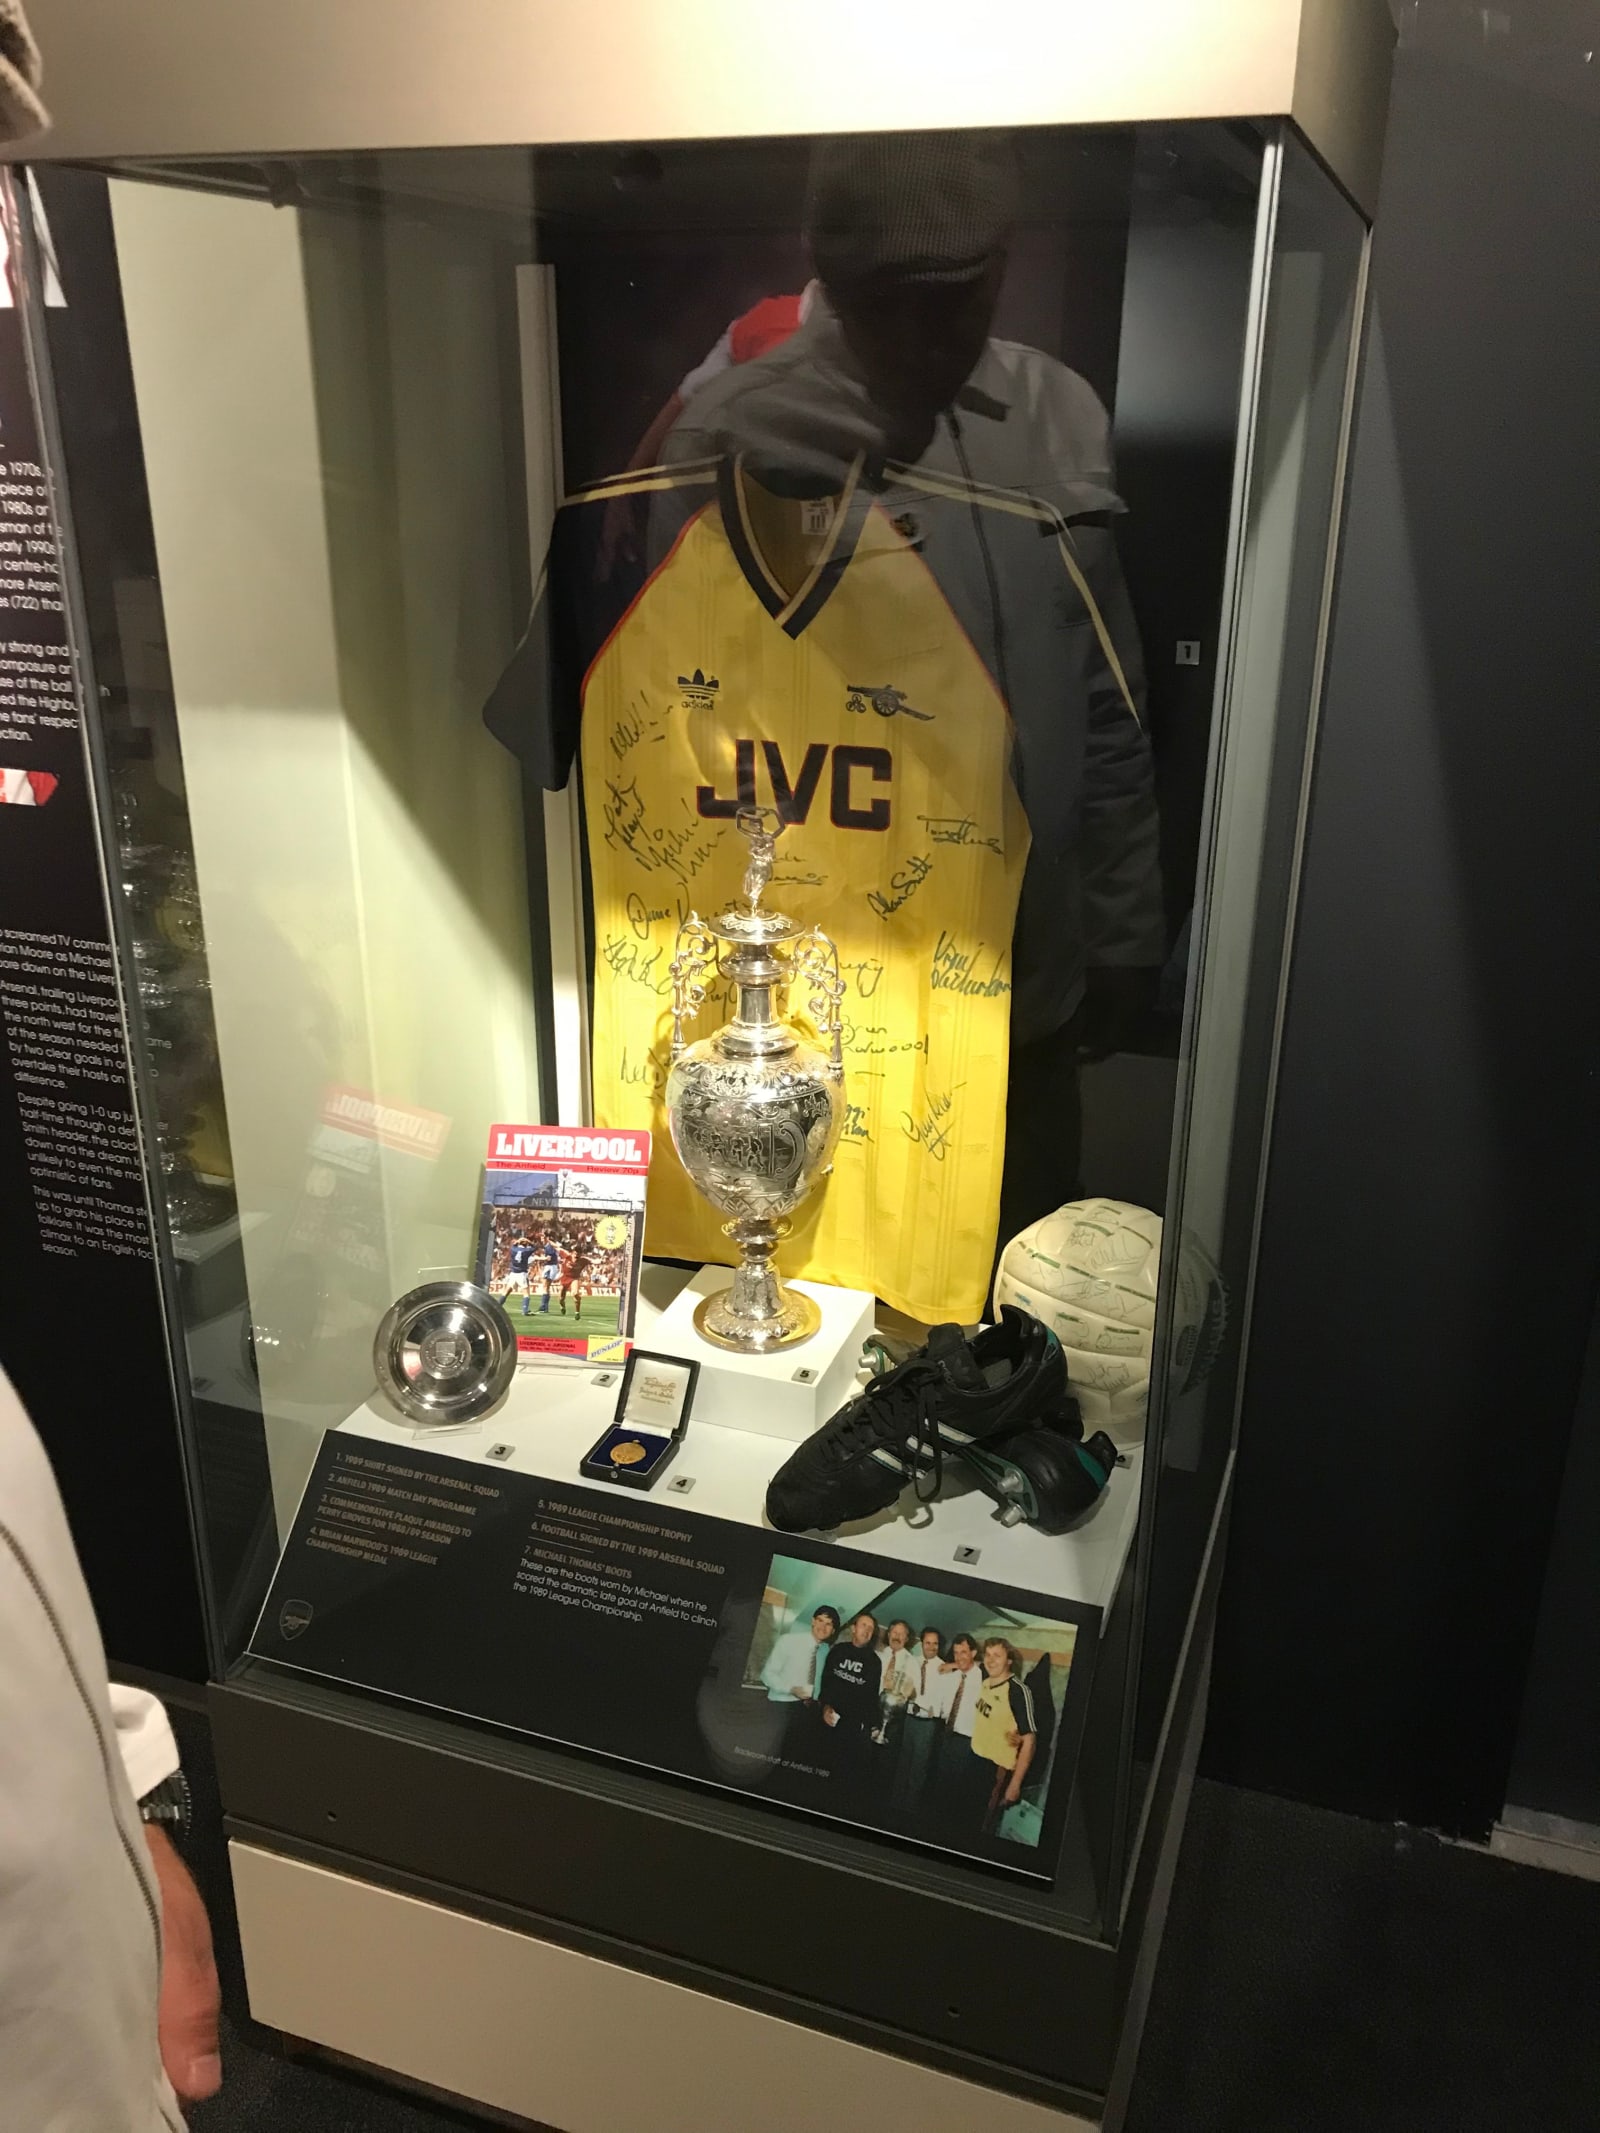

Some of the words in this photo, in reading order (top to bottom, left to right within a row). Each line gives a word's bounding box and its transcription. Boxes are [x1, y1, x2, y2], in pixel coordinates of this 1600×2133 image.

[1184, 645, 1191, 659] 1
[681, 700, 714, 710] adidas
[696, 738, 893, 832] JVC
[494, 1131, 643, 1163] LIVERPOOL
[591, 1340, 622, 1358] DUNLOP
[599, 1374, 610, 1382] 2
[799, 1369, 810, 1378] 5
[495, 1446, 506, 1456] 3
[473, 1485, 500, 1498] SQUAD
[676, 1478, 687, 1489] 4
[548, 1502, 569, 1513] 1989
[568, 1507, 598, 1520] LEAGUE
[598, 1514, 660, 1535] CHAMPIONSHIP
[659, 1529, 693, 1543] TROPHY
[540, 1524, 579, 1540] FOOTBALL
[580, 1533, 610, 1547] SIGNED
[609, 1541, 620, 1549] BY
[620, 1543, 637, 1554] THE
[638, 1547, 659, 1559] 1989
[658, 1552, 696, 1568] ARSENAL
[695, 1561, 726, 1575] SQUAD
[962, 1547, 975, 1558] 7
[521, 1558, 544, 1571] These
[544, 1566, 559, 1575] are
[560, 1568, 575, 1579] the
[575, 1572, 599, 1585] boots
[601, 1579, 621, 1591] worn
[622, 1584, 633, 1595] by
[634, 1586, 669, 1602] Michael
[670, 1596, 694, 1609] when
[695, 1601, 708, 1612] he
[513, 1582, 528, 1592] the
[530, 1586, 549, 1598] 1989
[548, 1591, 581, 1605] League
[516, 1571, 545, 1585] scored
[546, 1578, 560, 1588] the
[560, 1583, 599, 1598] dramatic
[599, 1591, 617, 1602] late
[617, 1597, 638, 1607] goal
[638, 1602, 649, 1610] at
[649, 1603, 680, 1618] Anfield
[680, 1611, 690, 1621] to
[690, 1614, 718, 1628] clinch
[838, 1658, 864, 1674] JVC
